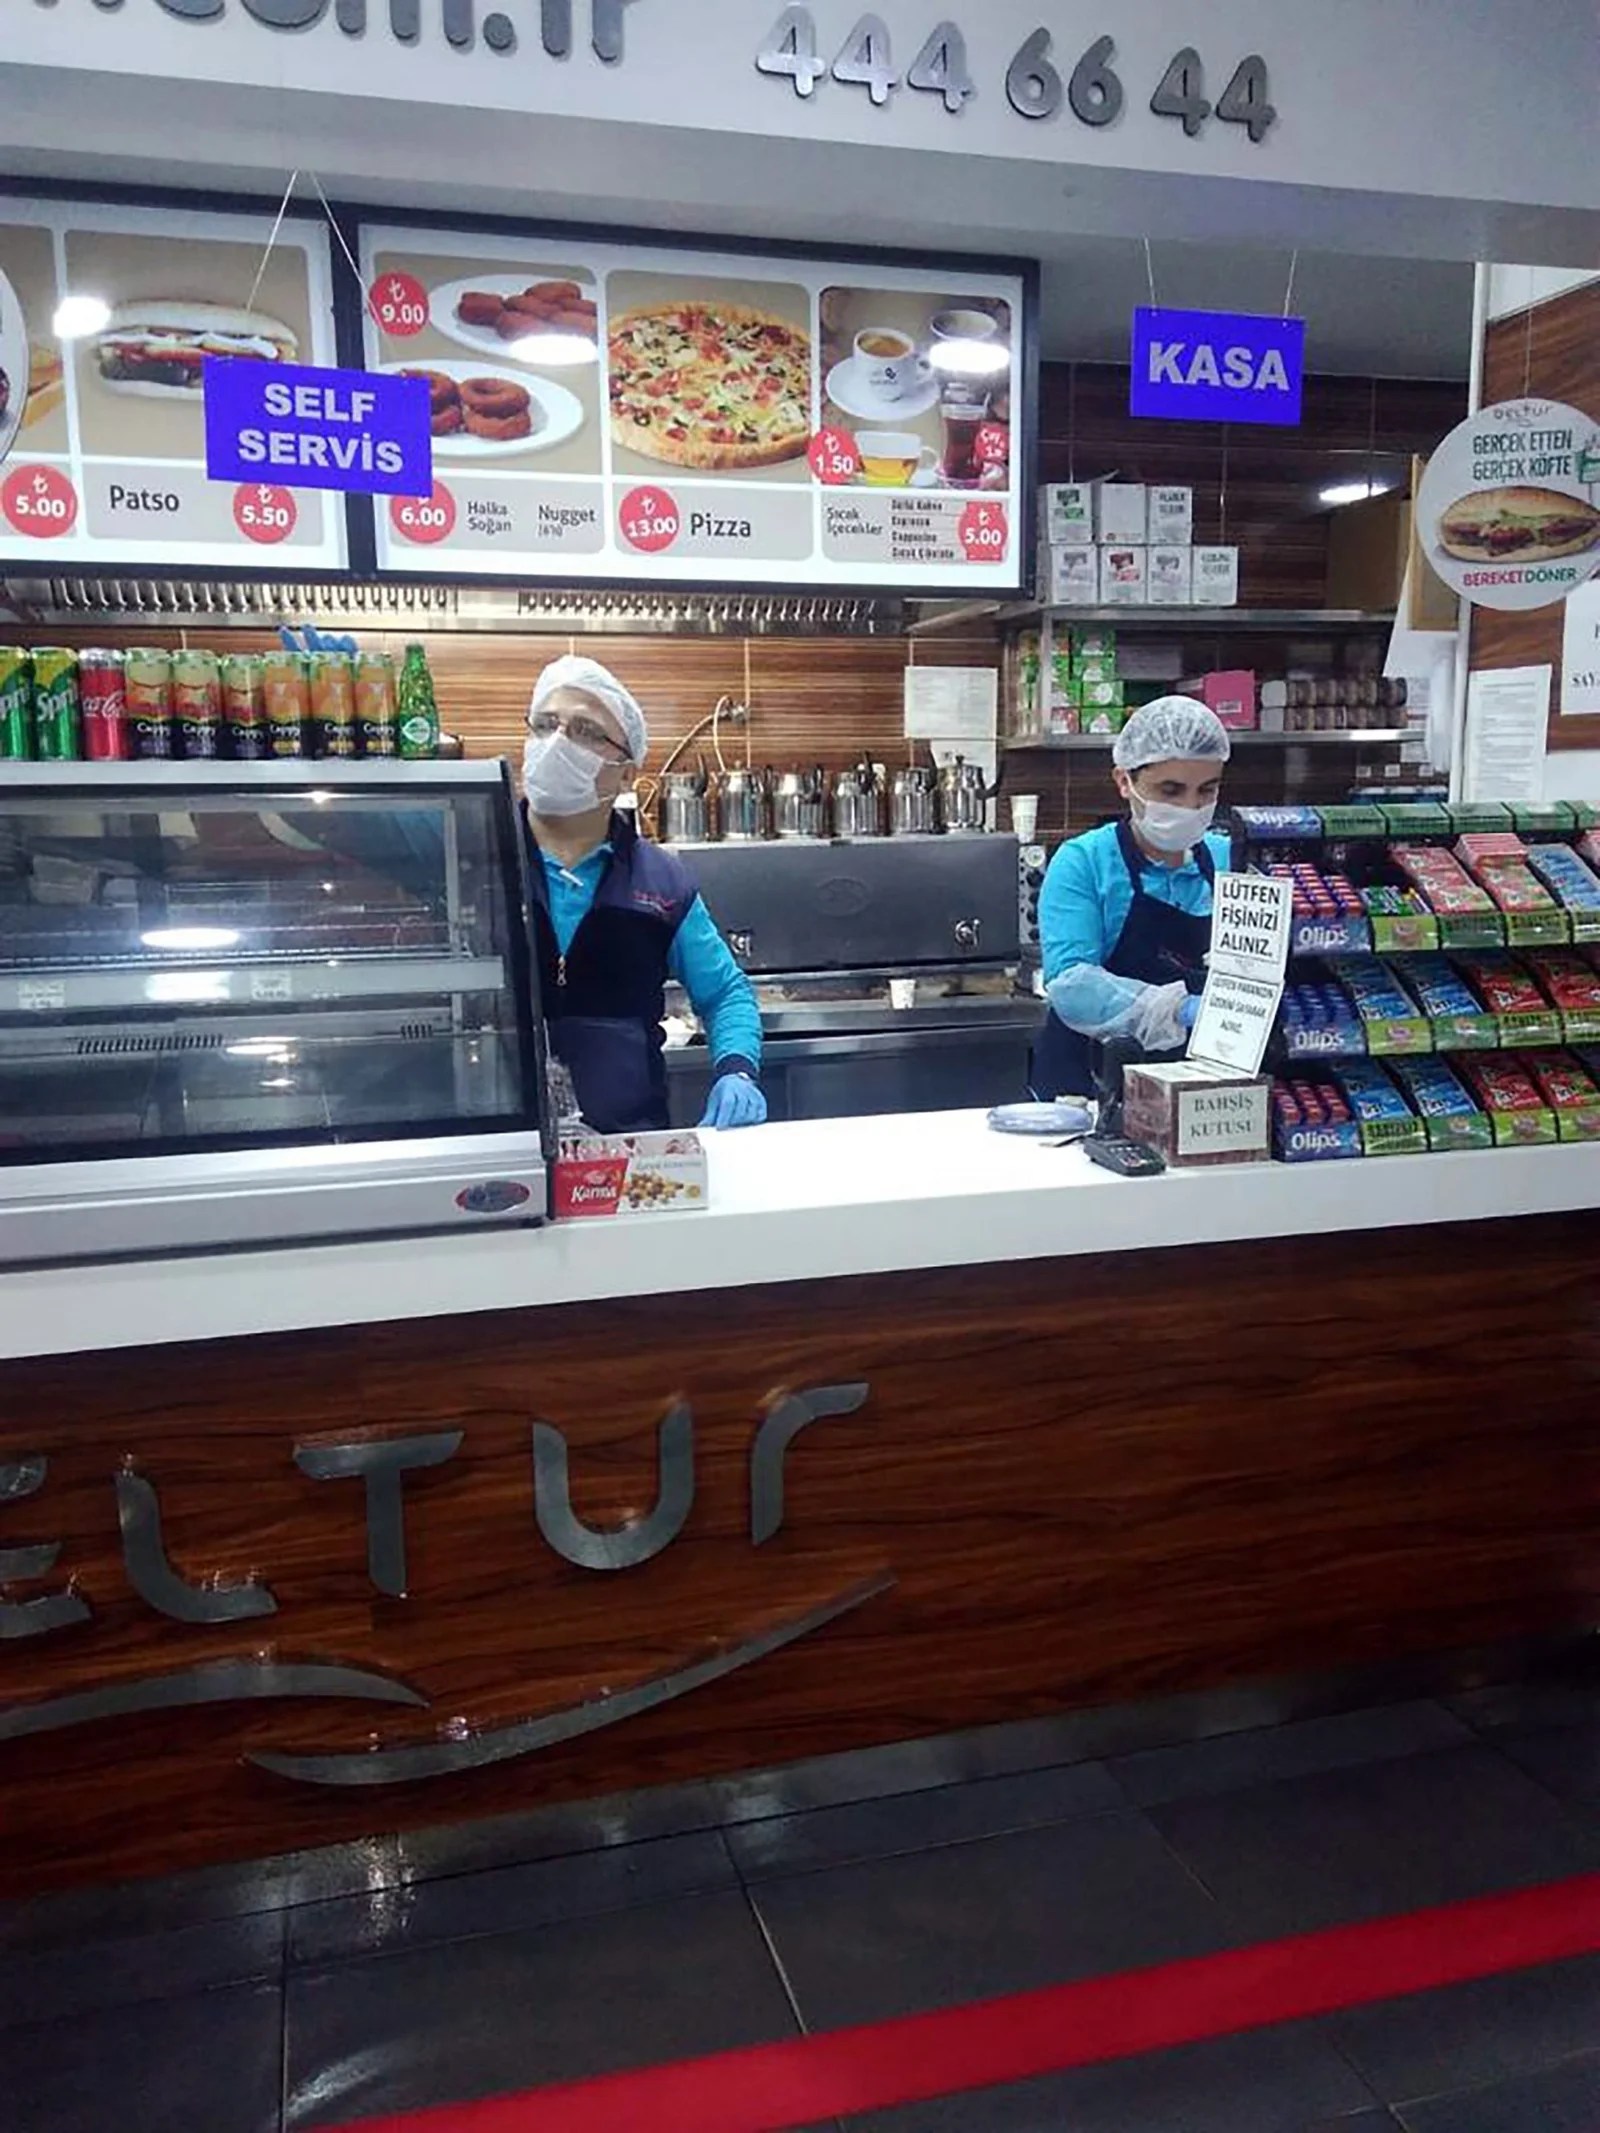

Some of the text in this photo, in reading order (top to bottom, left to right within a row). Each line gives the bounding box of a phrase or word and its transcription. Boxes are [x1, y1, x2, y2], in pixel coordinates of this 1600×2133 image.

[756, 4, 978, 112] 444
[1006, 27, 1123, 126] 66
[1150, 46, 1278, 143] 44
[382, 304, 425, 324] 9.00
[1150, 341, 1290, 391] KASA
[264, 383, 375, 423] SELF
[238, 428, 403, 474] SERVİS
[1473, 430, 1572, 460] GERÇEK ETTEN
[815, 455, 854, 474] 1.50
[1473, 453, 1571, 483] GERÇEK KÖFTE
[15, 496, 66, 518] 5.00
[109, 485, 180, 512] Patso
[467, 502, 508, 516] Halka
[242, 505, 288, 526] 5.50
[401, 507, 447, 526] 6.00
[538, 505, 596, 526] Nugget
[691, 512, 752, 538] Pizza
[626, 516, 677, 538] 13.00
[965, 528, 1001, 545] 5.00
[1222, 879, 1281, 905] LÜTFEN
[1221, 906, 1279, 933] FİŞİNİZİ
[1220, 932, 1273, 957] ALINIZ.
[1300, 926, 1349, 948] Olips
[1295, 1030, 1344, 1049] Olips
[1291, 1131, 1341, 1153] Olips
